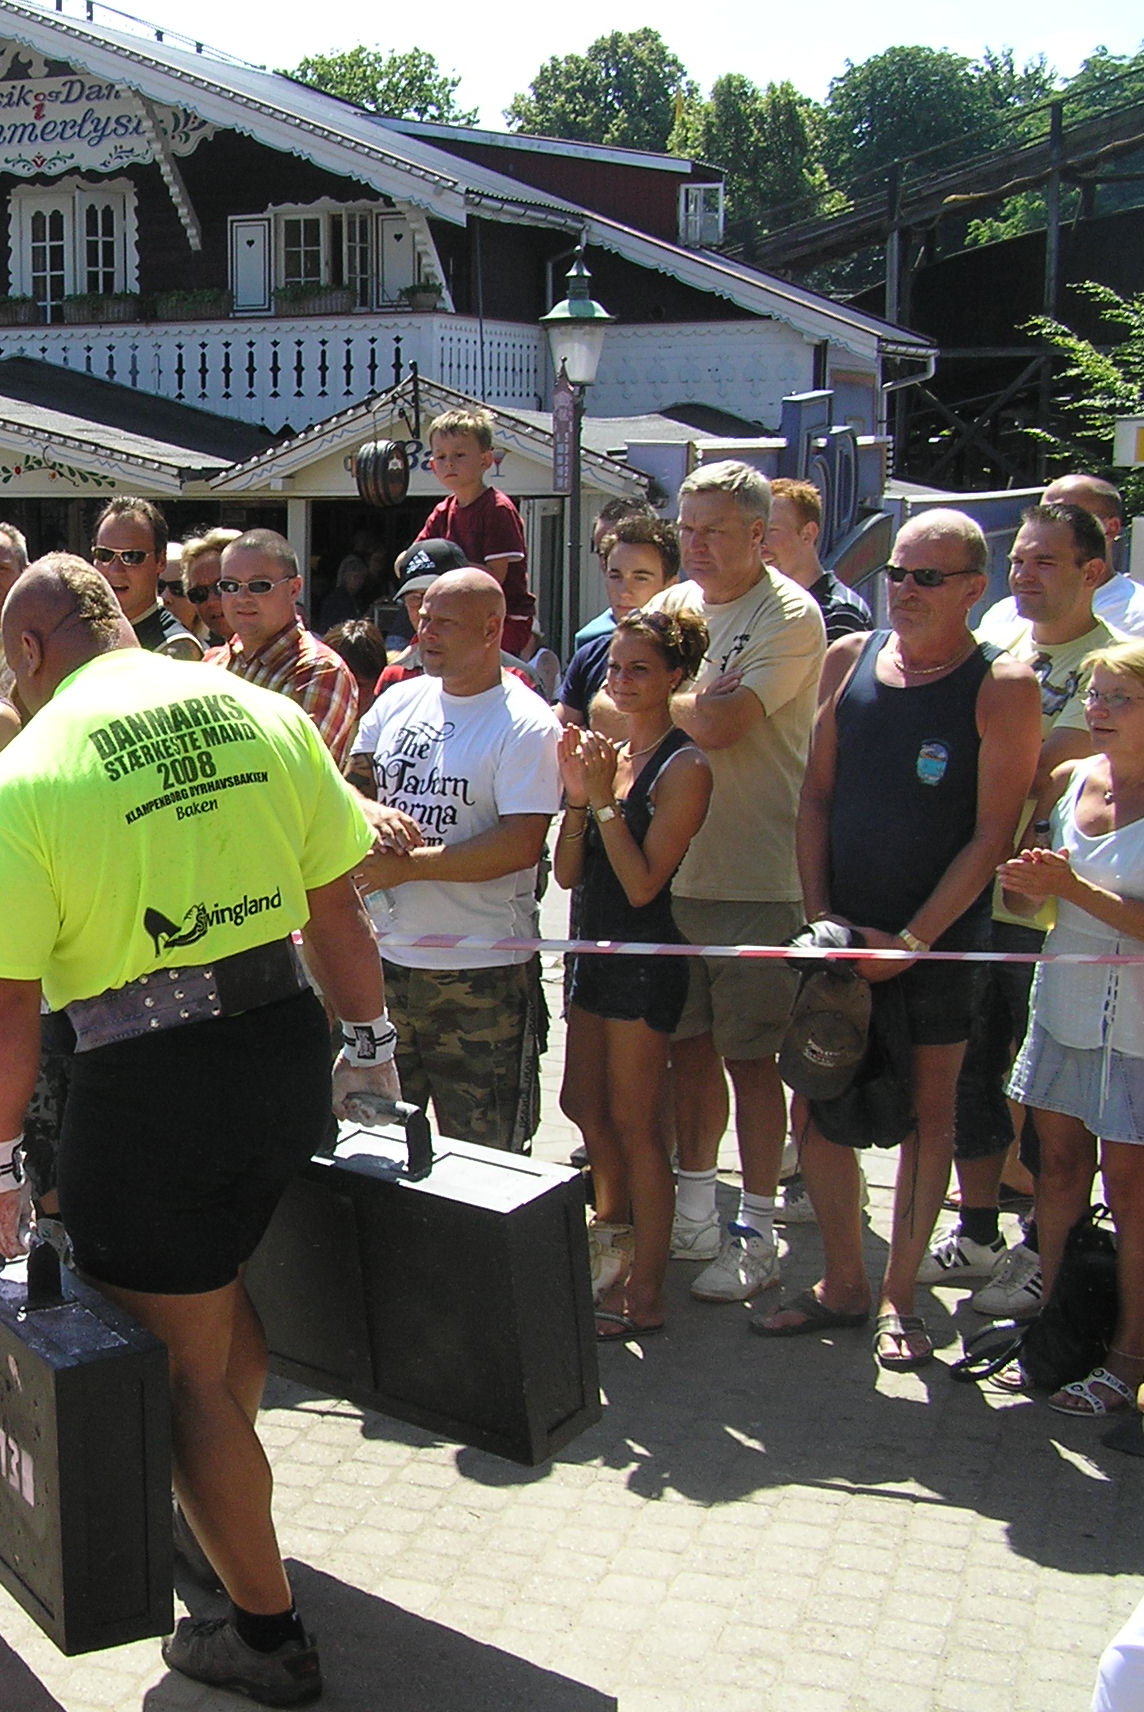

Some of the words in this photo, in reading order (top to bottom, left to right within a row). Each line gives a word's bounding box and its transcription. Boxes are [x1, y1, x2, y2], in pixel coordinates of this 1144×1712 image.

[60, 79, 121, 104] Dan
[88, 694, 244, 761] DANMARKS
[201, 722, 256, 748] MAND
[390, 723, 438, 759] The
[156, 751, 217, 790] 2008
